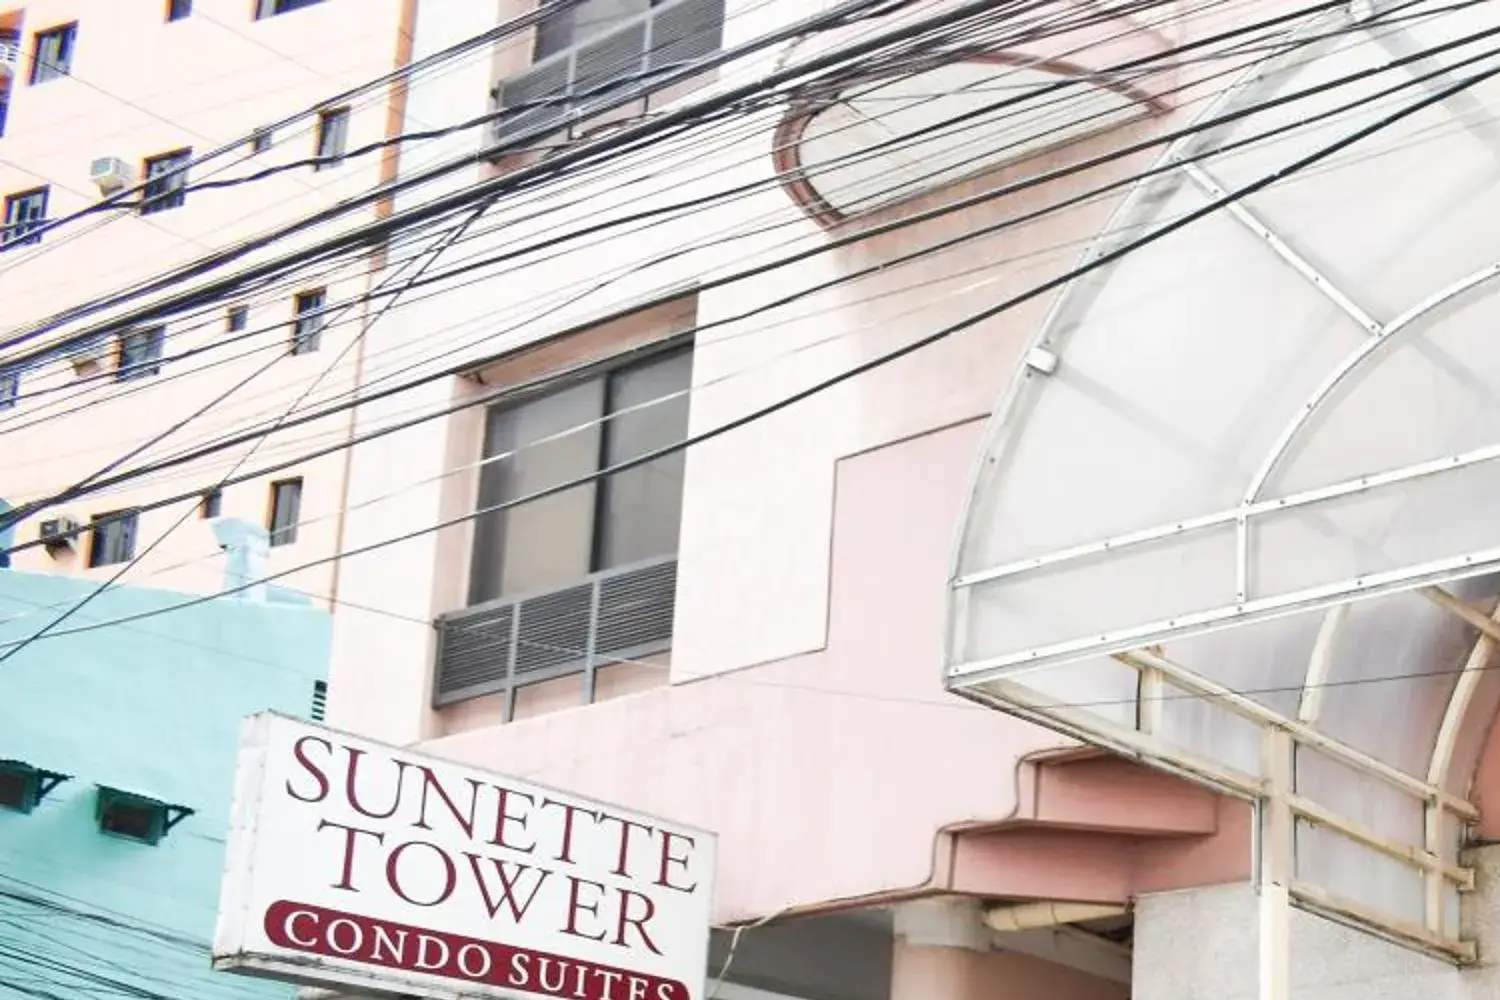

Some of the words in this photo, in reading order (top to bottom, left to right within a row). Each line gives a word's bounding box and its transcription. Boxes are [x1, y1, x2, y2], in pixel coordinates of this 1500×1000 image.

[286, 735, 698, 894] SUNETTE
[283, 910, 493, 979] CONDO
[317, 819, 665, 957] TOWER
